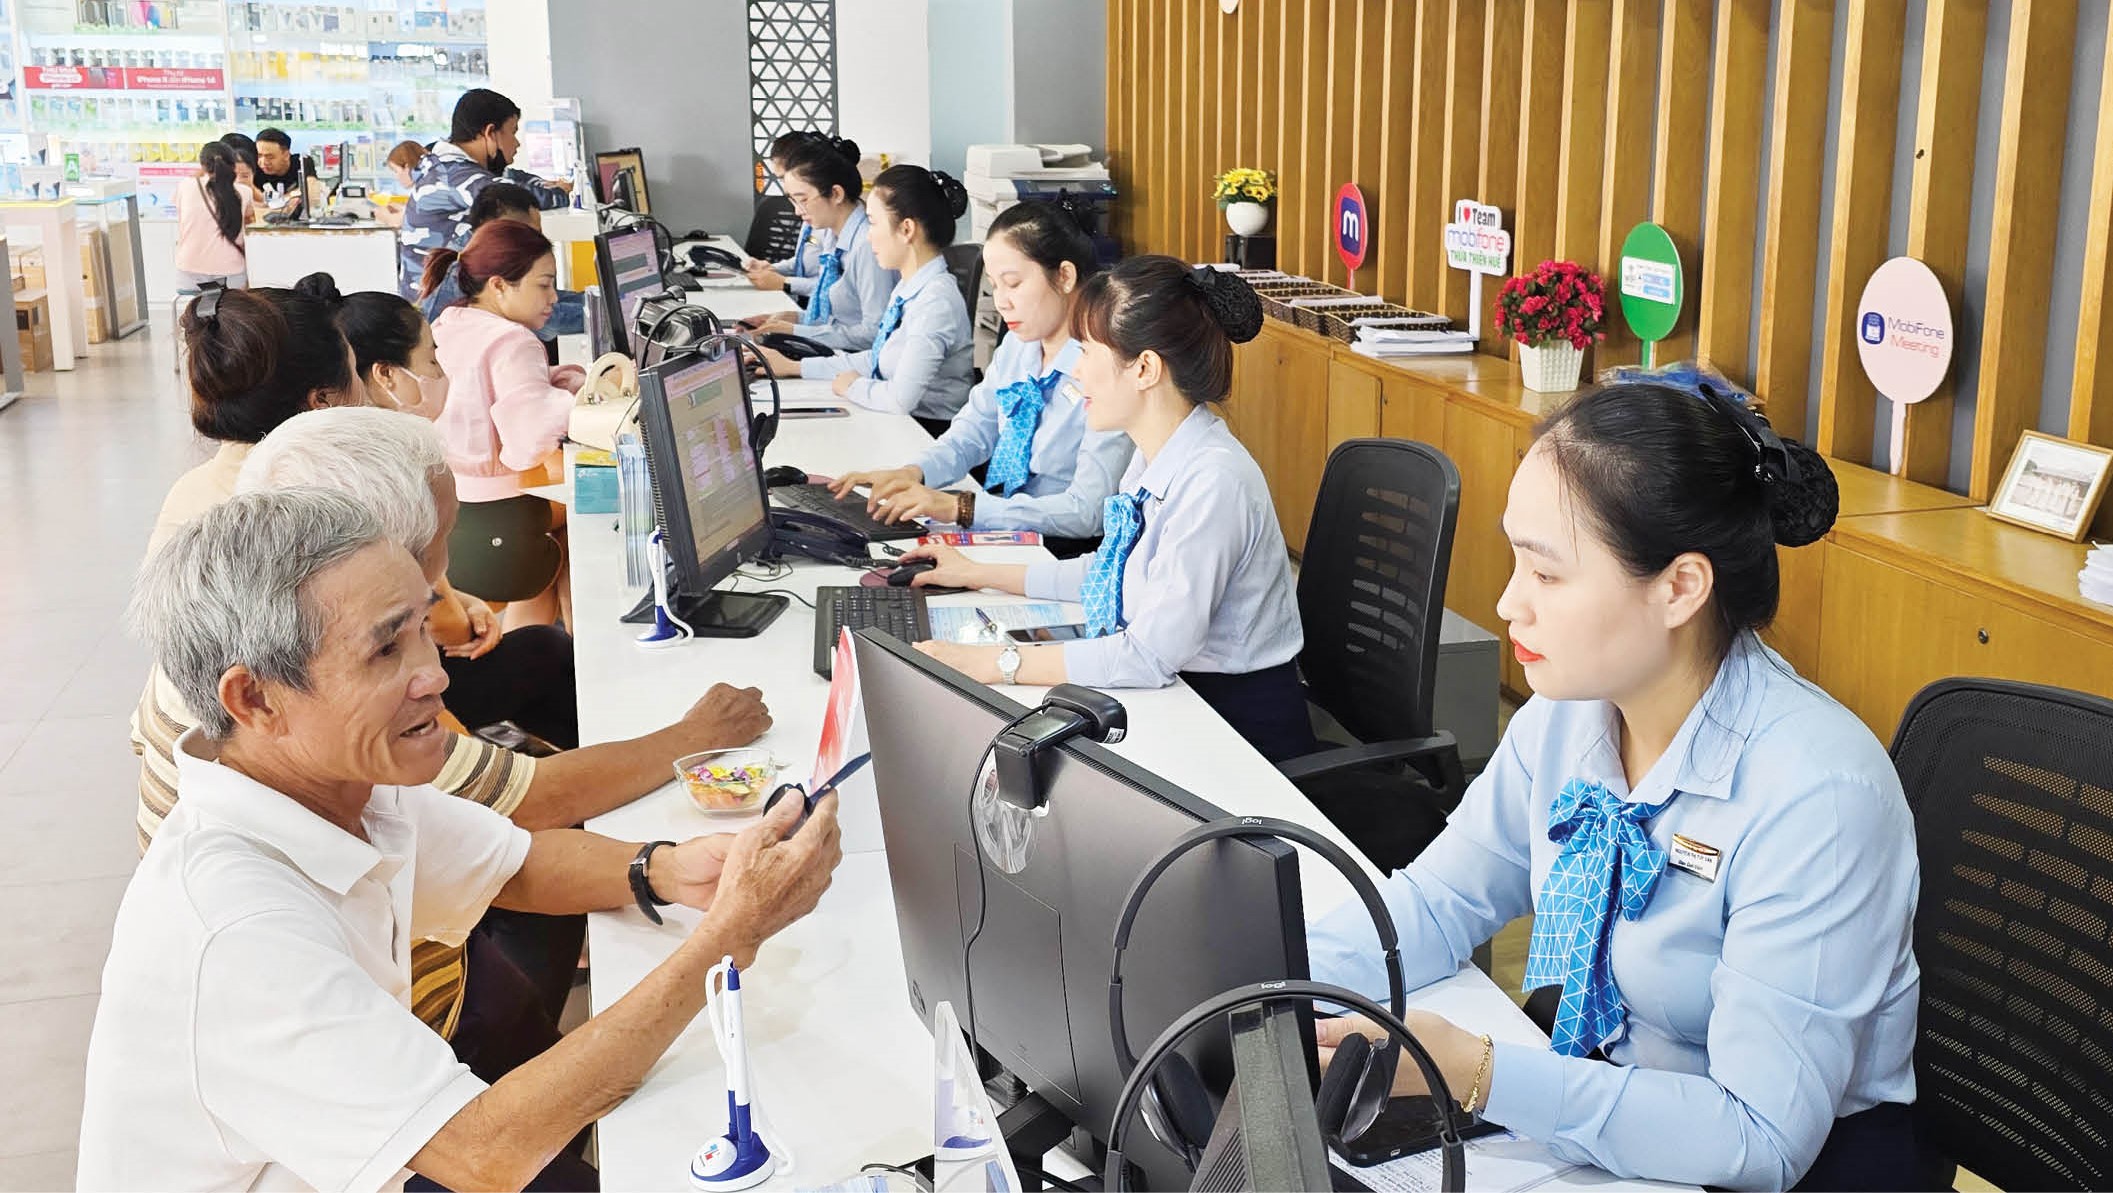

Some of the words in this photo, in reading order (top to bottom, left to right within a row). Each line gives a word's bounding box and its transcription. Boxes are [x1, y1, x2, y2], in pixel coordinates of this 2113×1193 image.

[1458, 207, 1462, 223] I
[1472, 208, 1496, 227] Team
[1447, 226, 1505, 253] mobifone
[1887, 316, 1945, 340] MobiFone
[1890, 334, 1939, 358] Meeting
[1241, 817, 1263, 825] logi
[1261, 981, 1286, 989] logi
